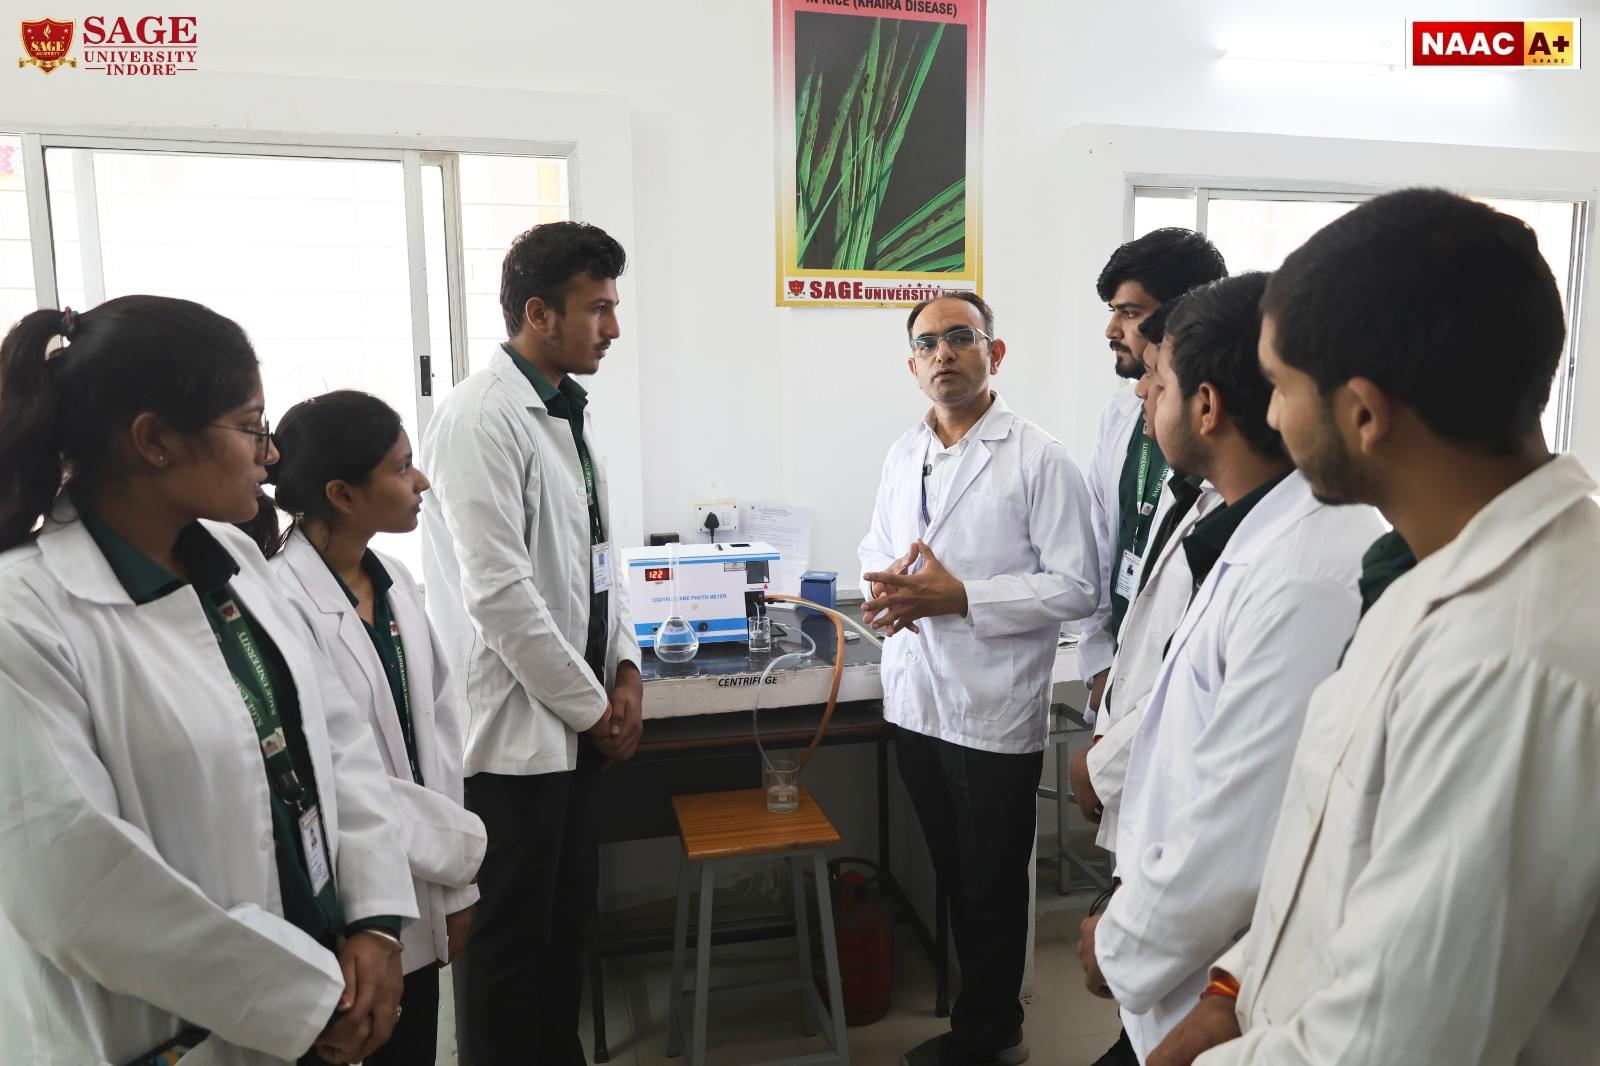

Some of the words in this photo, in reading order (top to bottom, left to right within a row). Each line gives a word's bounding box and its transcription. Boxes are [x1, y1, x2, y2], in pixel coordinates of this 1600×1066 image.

[905, 0, 958, 18] DISEASE)
[809, 280, 864, 300] SAGE
[865, 288, 939, 302] UNIVERSITY
[649, 570, 664, 579] 122
[236, 631, 270, 688] UNIVERSITY
